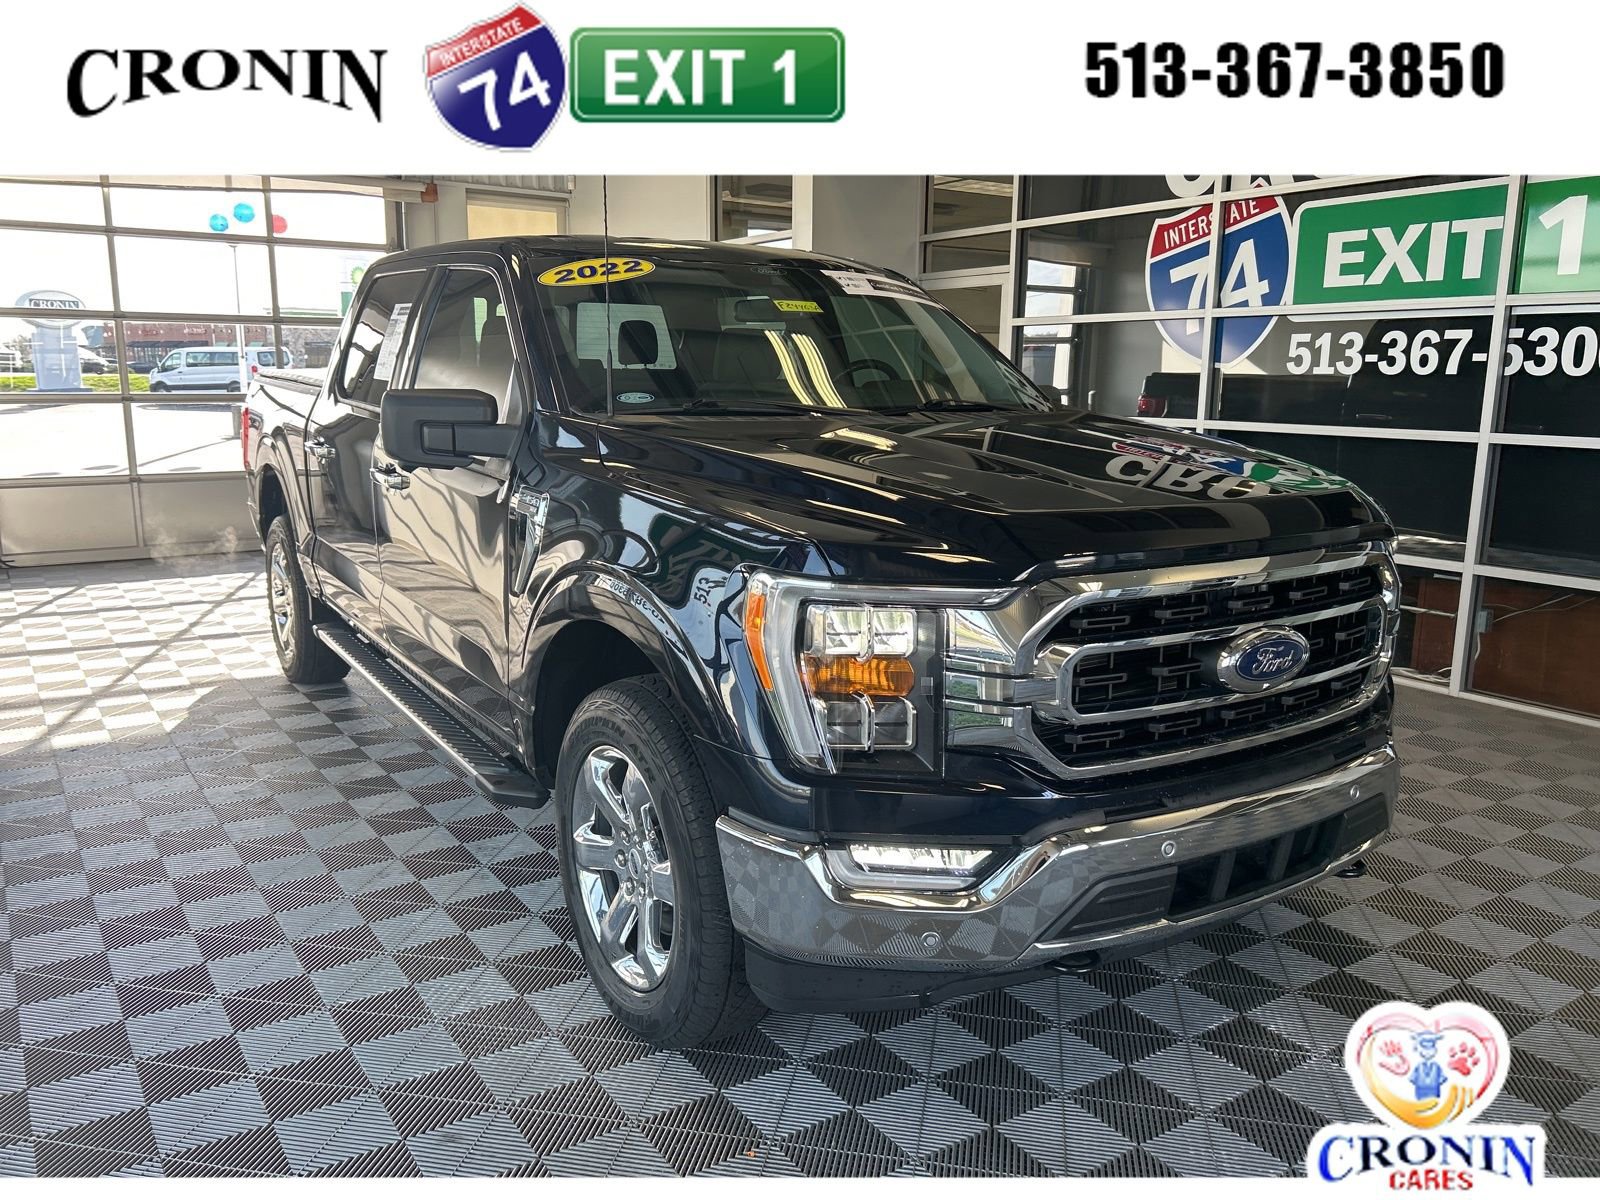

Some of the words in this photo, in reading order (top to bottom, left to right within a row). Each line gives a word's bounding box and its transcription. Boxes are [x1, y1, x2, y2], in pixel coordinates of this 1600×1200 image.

[1164, 199, 1260, 249] INTERSATE
[1323, 215, 1505, 288] EXIT
[1538, 195, 1588, 275] 1
[554, 260, 643, 283] 2022
[1169, 239, 1269, 335] 74
[30, 300, 79, 308] CRONIN
[1286, 326, 1600, 377] 513-367-530
[1251, 646, 1294, 675] Ford
